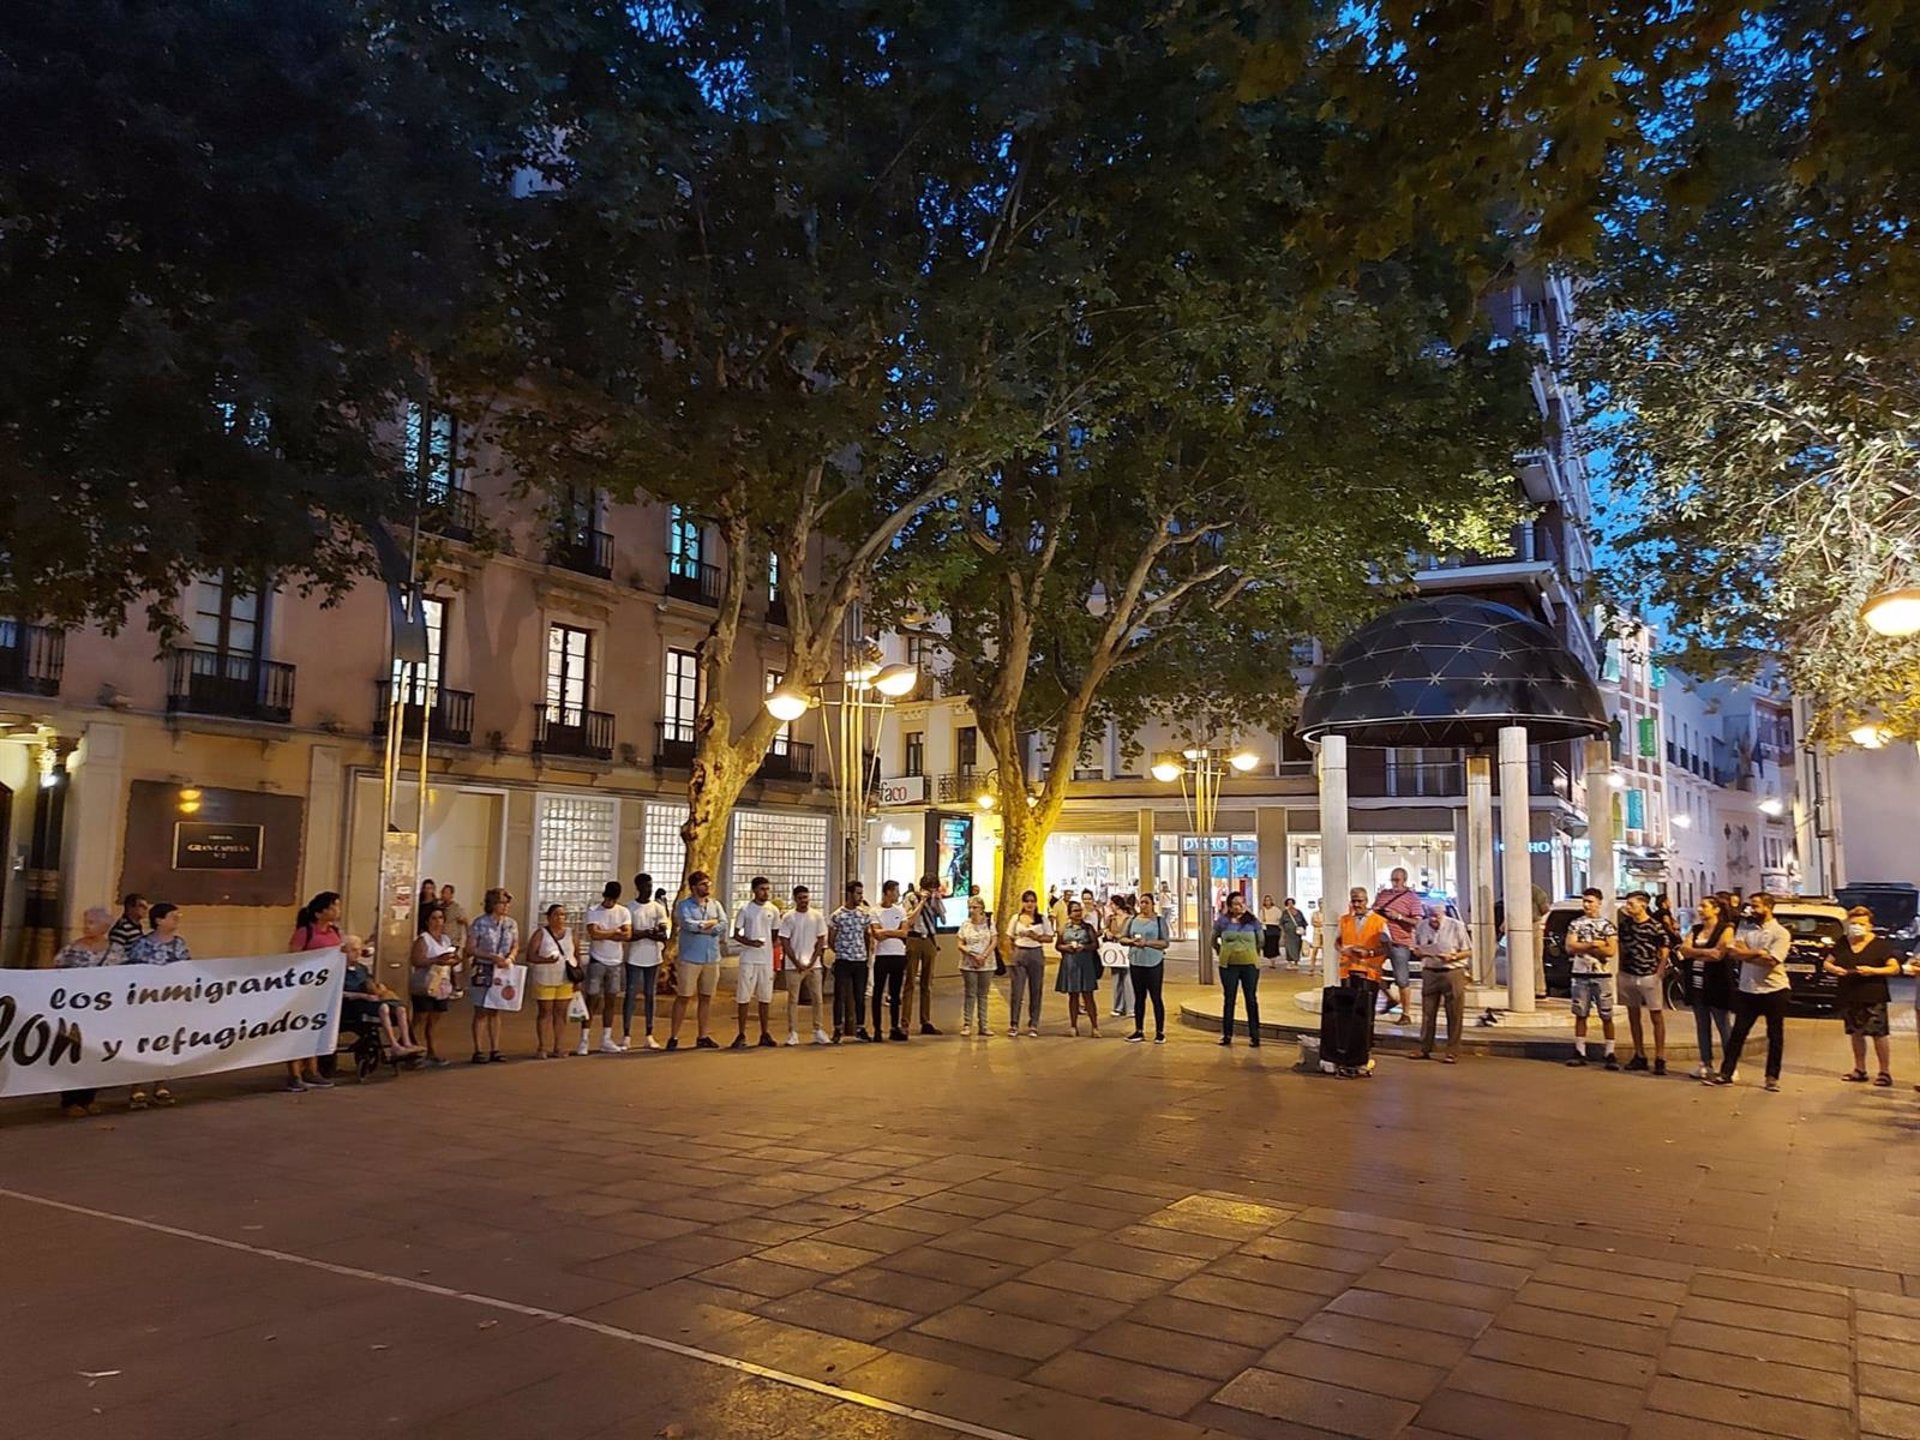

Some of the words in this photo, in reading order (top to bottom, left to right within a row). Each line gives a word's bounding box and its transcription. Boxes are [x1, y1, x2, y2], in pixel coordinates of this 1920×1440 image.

[50, 987, 112, 1010] los
[126, 967, 329, 1004] inmigrantes
[101, 1039, 123, 1062] y
[136, 1011, 328, 1055] refugiados
